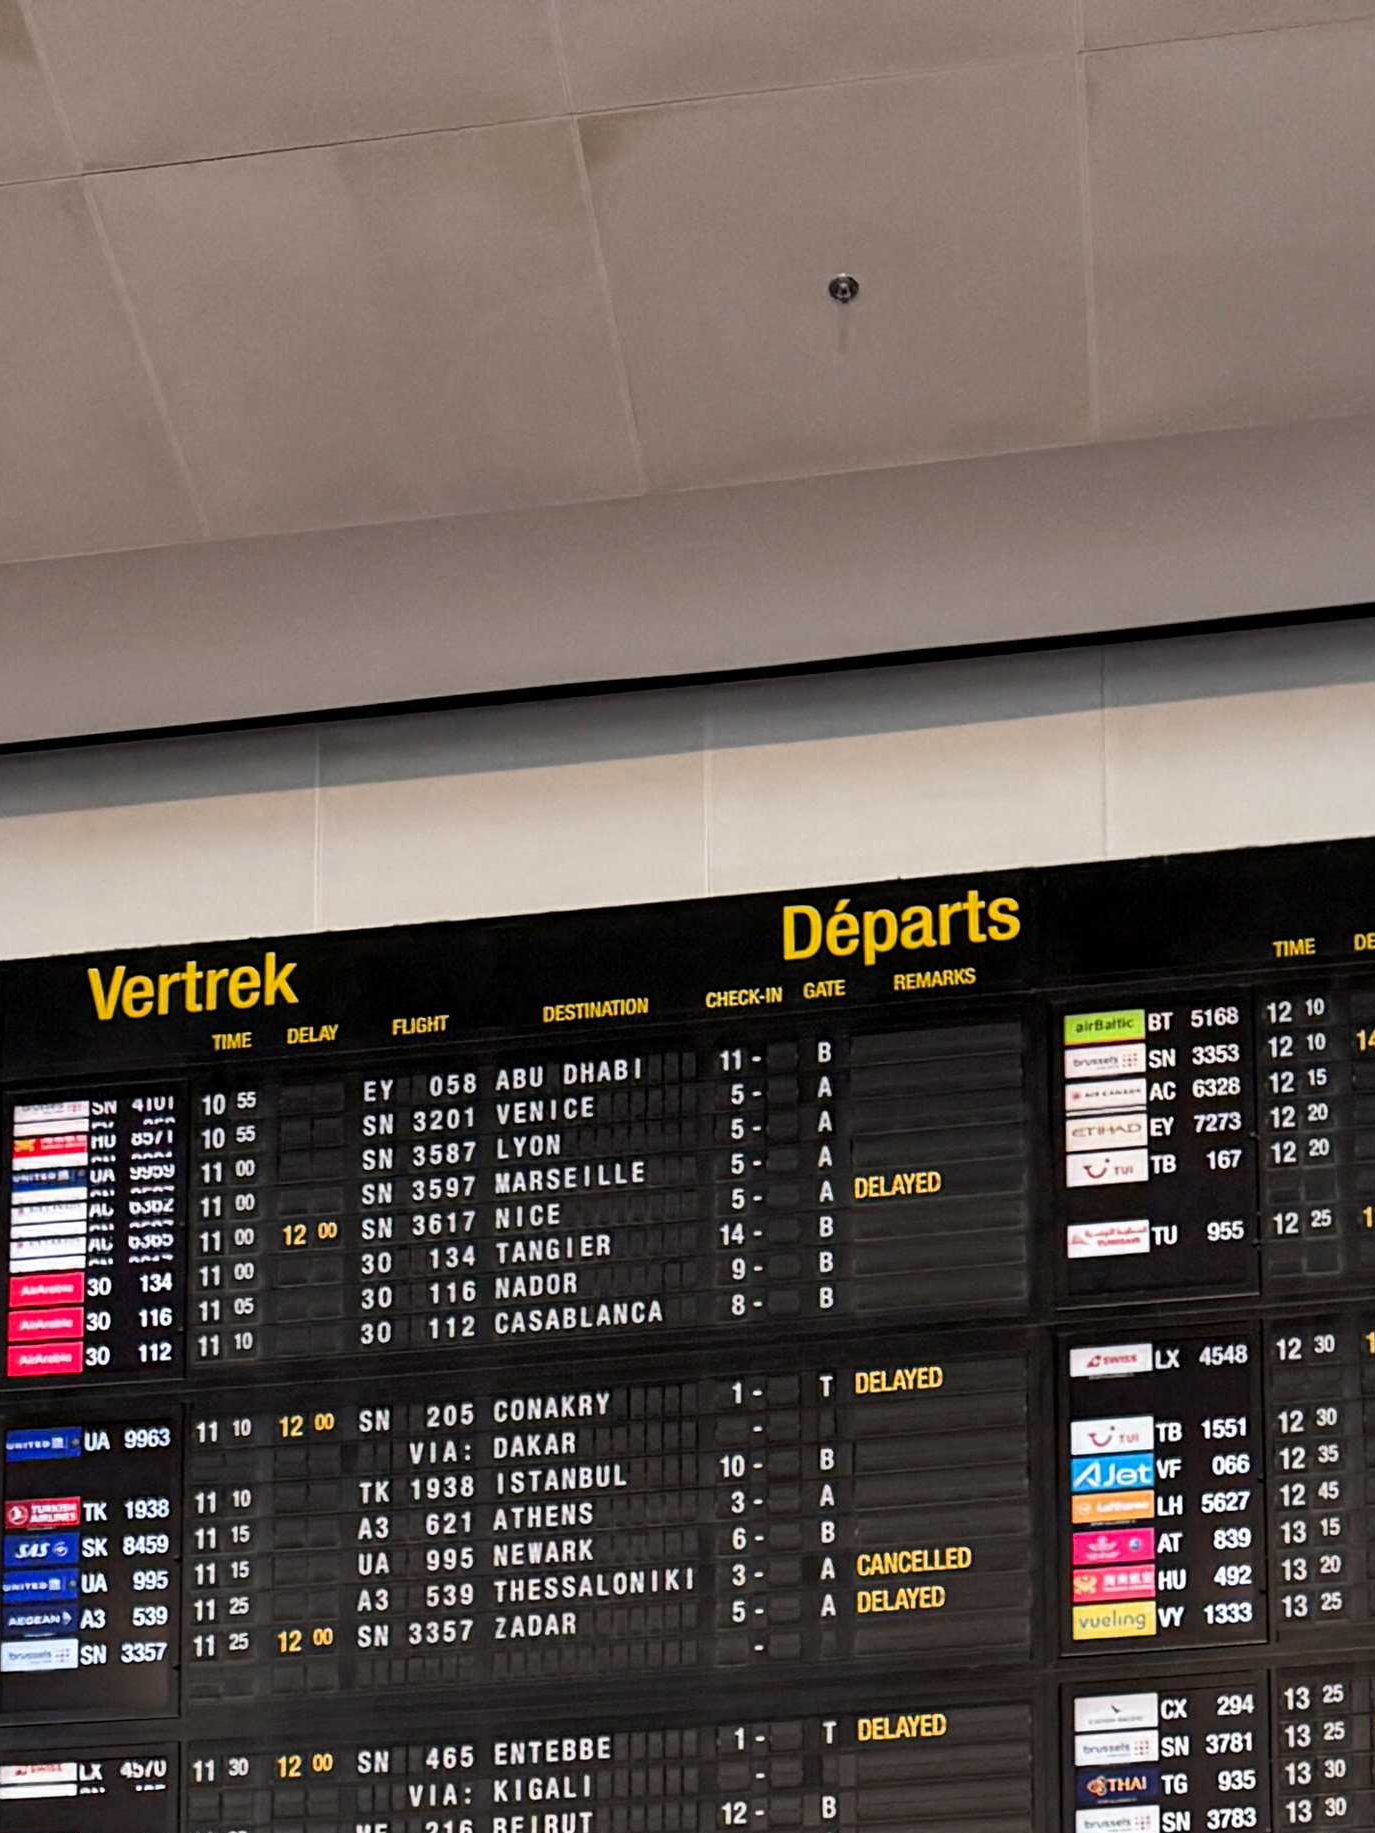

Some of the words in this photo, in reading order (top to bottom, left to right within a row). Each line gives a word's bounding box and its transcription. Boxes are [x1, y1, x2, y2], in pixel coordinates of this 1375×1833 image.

[784, 891, 1020, 965] Départs
[1273, 939, 1315, 956] TIME
[88, 952, 298, 1019] Vertrek
[213, 1032, 251, 1049] TIME
[288, 1025, 338, 1043] DELAY
[393, 1016, 448, 1034] FLIGHT
[544, 998, 648, 1022] DESTINATION
[706, 988, 782, 1007] CHECK-IN
[804, 980, 845, 998] GATE
[894, 968, 975, 990] REMARKS
[1075, 1018, 1134, 1033] airBaltic
[496, 1067, 542, 1090] ABU
[564, 1059, 640, 1084] DHABI
[497, 1097, 593, 1124] VENICE
[498, 1135, 559, 1158] LYON
[496, 1162, 643, 1193] MARSEILLE
[496, 1204, 559, 1228] NICE
[855, 1172, 941, 1198] DELAYED
[497, 1235, 610, 1263] TANGIER
[496, 1301, 662, 1333] CASABLANCA
[494, 1393, 609, 1422] CONAKRY
[856, 1367, 942, 1393] DELAYED
[494, 1503, 592, 1530] ATHENS
[494, 1539, 592, 1566] NEWARK
[494, 1568, 692, 1602] THESSALONIKI
[857, 1547, 971, 1576] CANCELLED
[496, 1613, 575, 1638] ZADAR
[1078, 1610, 1146, 1630] vueling
[495, 1737, 610, 1765] ENTEBBE
[858, 1714, 946, 1741] DELAYED
[494, 1775, 589, 1802] KIGALI
